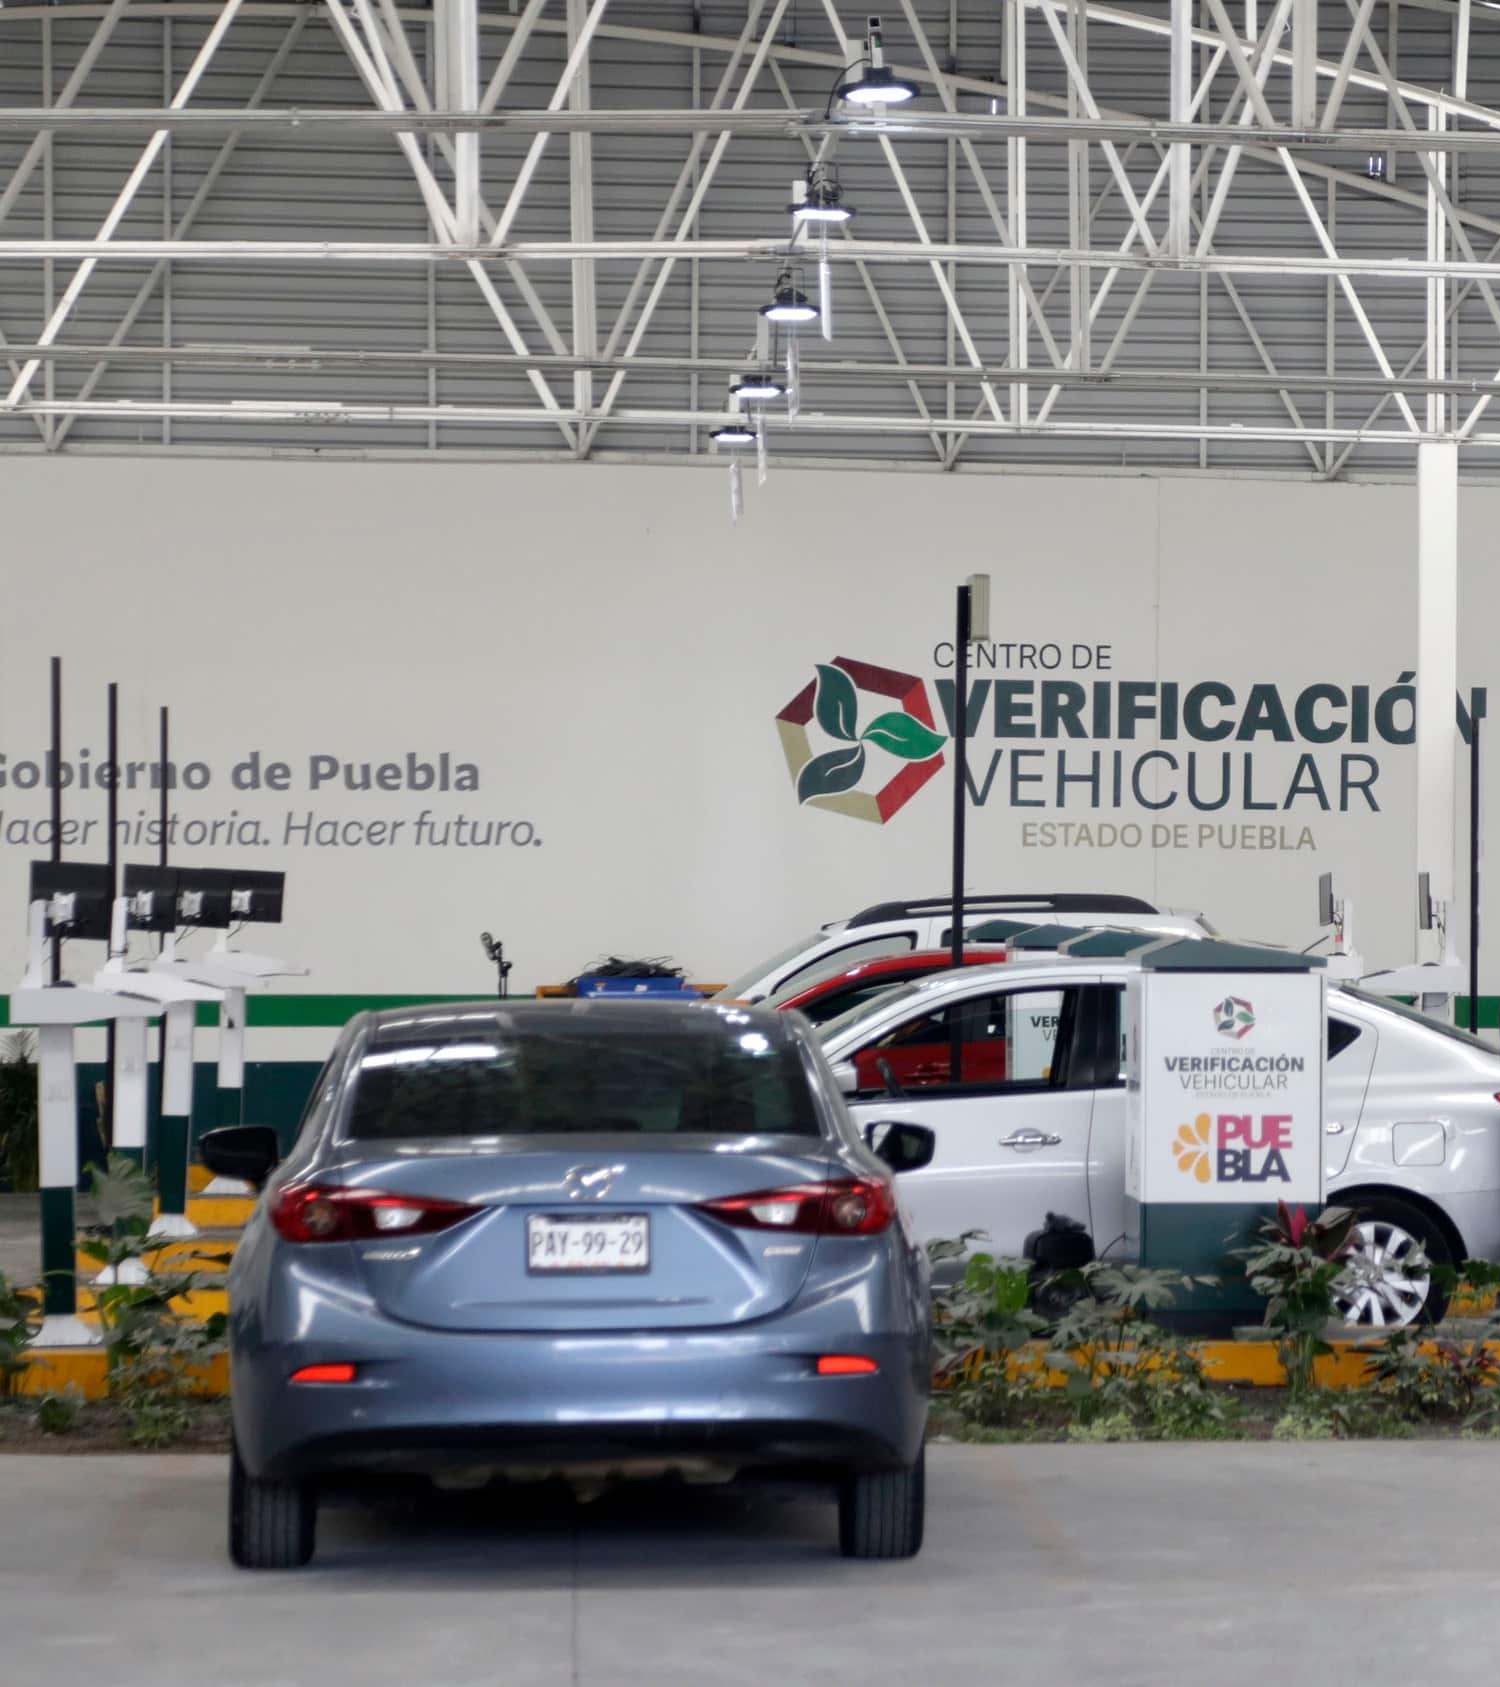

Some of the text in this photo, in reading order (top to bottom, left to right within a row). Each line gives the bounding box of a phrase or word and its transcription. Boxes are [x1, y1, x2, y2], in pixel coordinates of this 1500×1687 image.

[933, 642, 1112, 670] CENTRO DE
[0, 748, 479, 791] obierno de Puebla
[961, 748, 1381, 812] VEHICULAR
[0, 810, 98, 846] acer
[283, 811, 406, 847] Hacer
[413, 810, 543, 847] futuro.
[1021, 822, 1317, 851] ESTADO DE PUEBLA
[1164, 1053, 1305, 1072] VERIFICACIÓN
[1180, 1074, 1288, 1090] VEHICULAR
[1217, 1115, 1293, 1149] PUE
[1217, 1149, 1291, 1182] BLA
[531, 1231, 643, 1256] PAY-99-29
